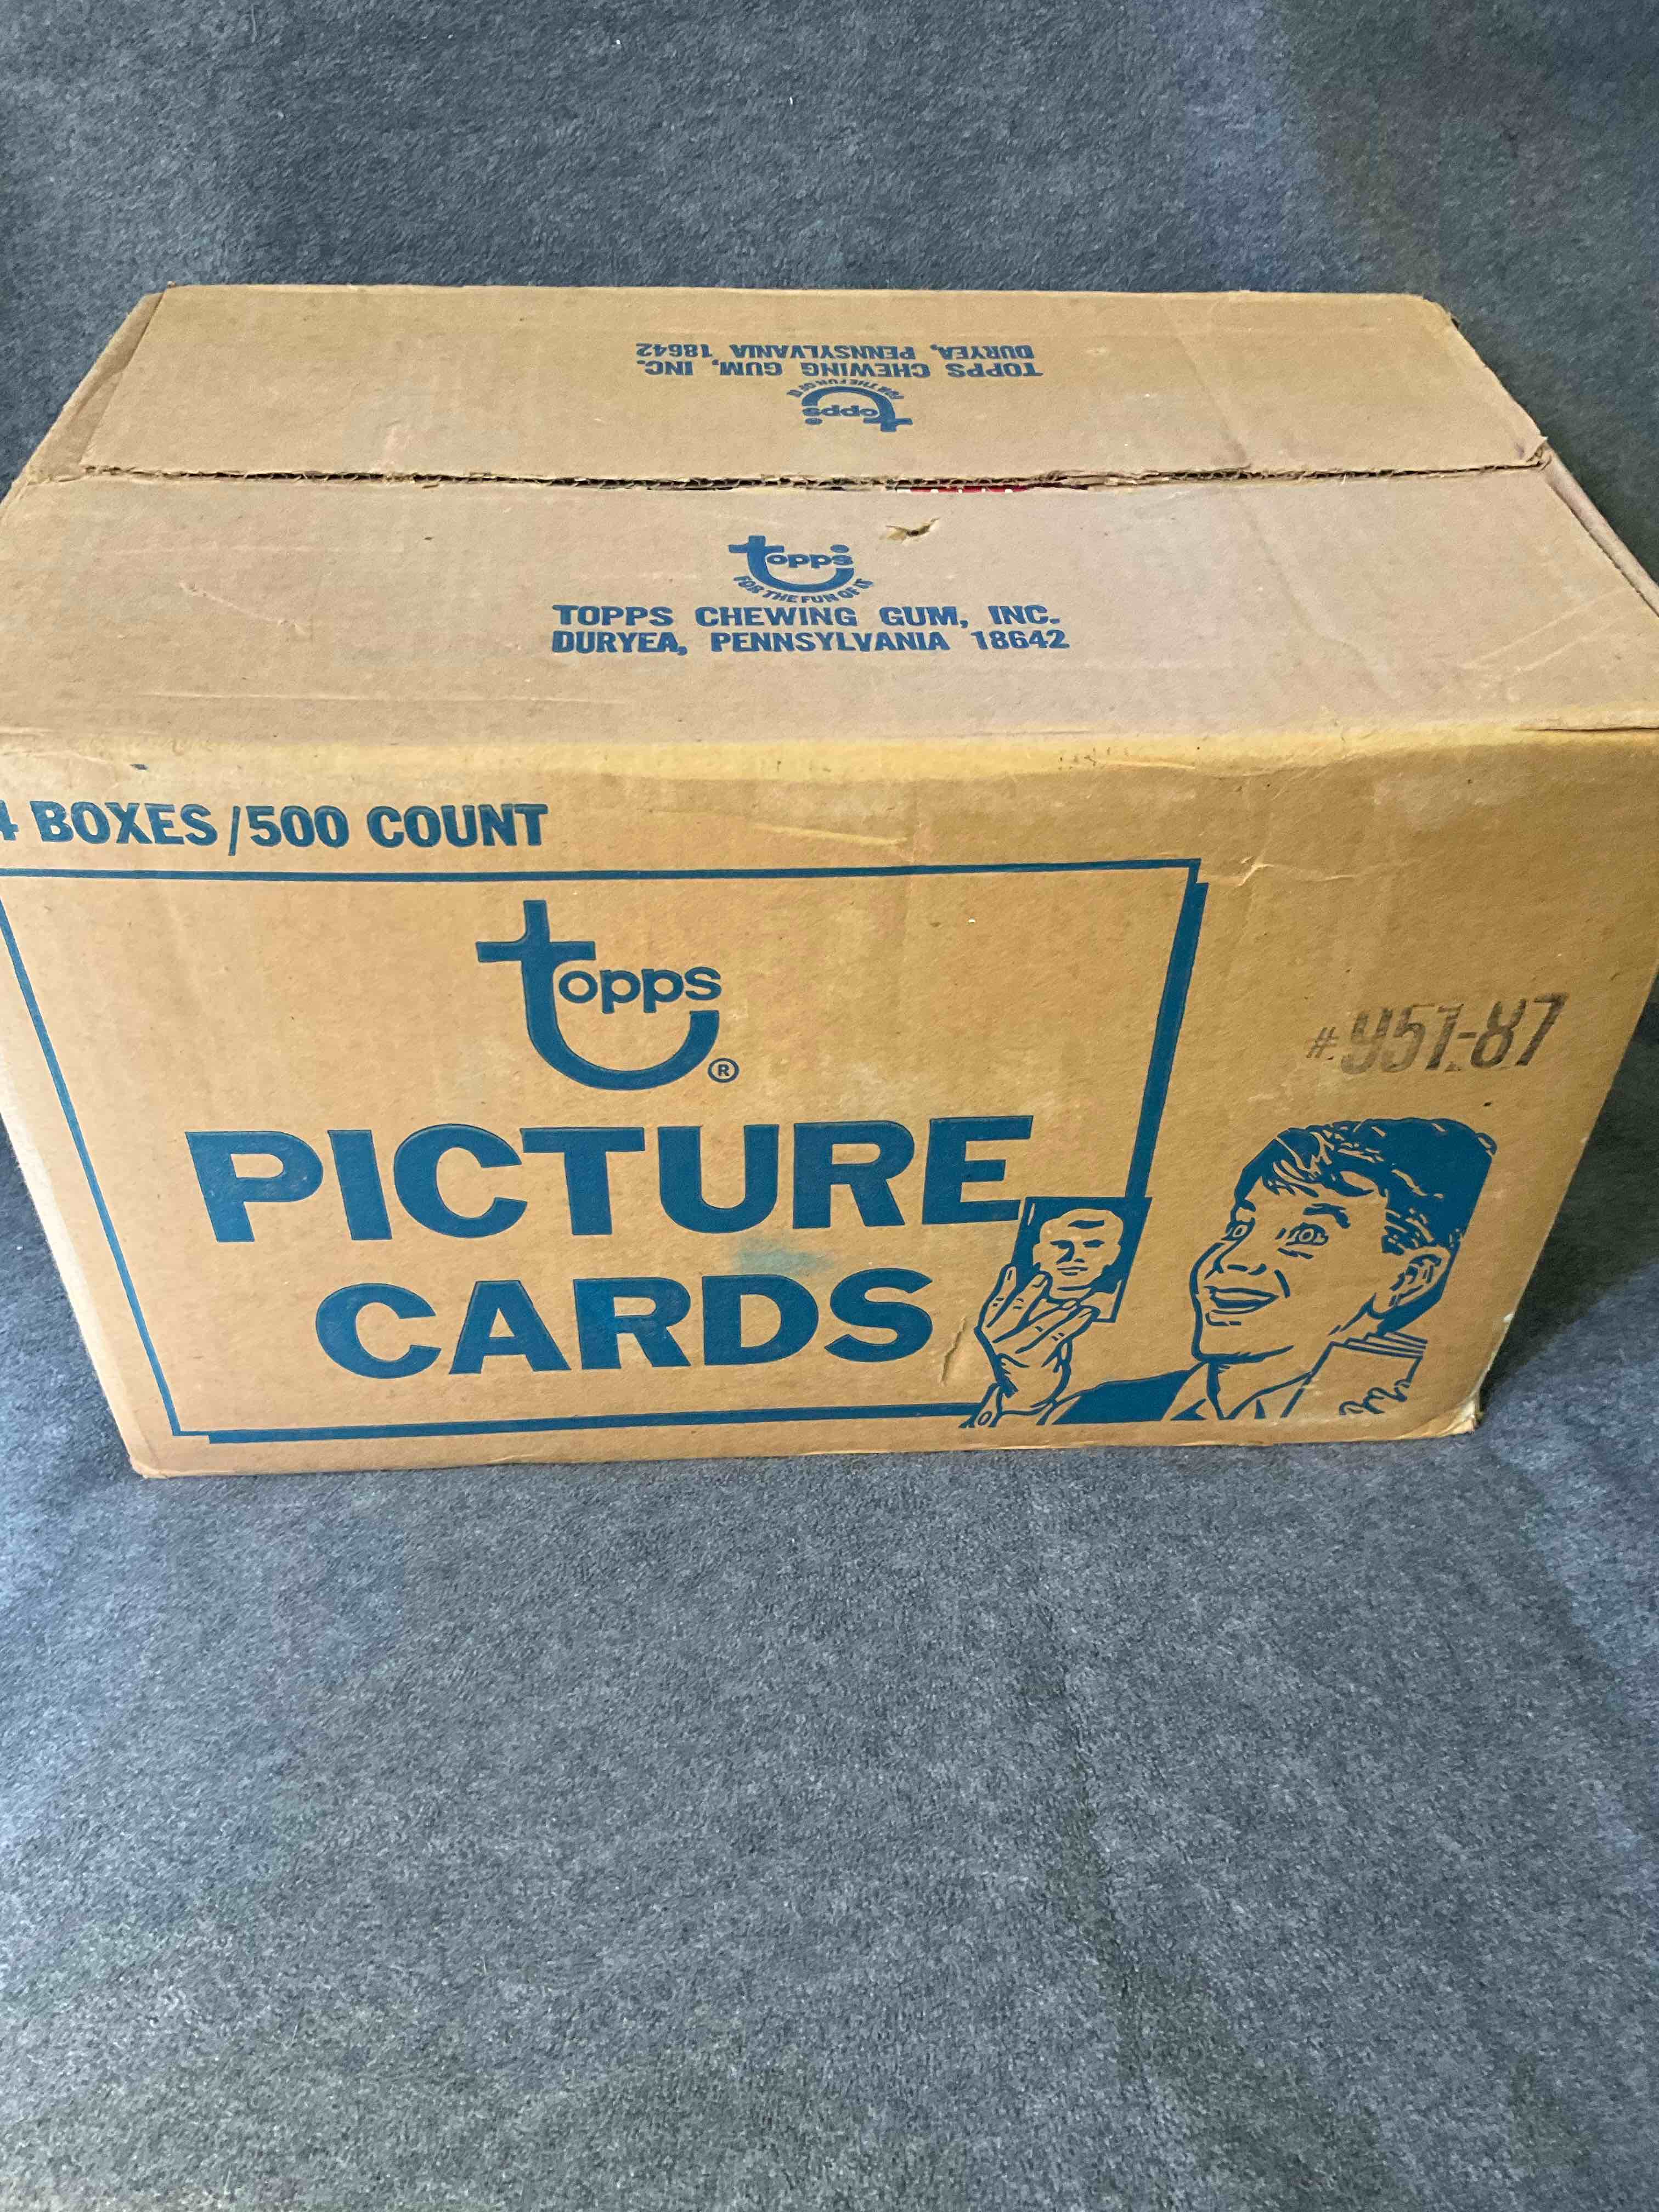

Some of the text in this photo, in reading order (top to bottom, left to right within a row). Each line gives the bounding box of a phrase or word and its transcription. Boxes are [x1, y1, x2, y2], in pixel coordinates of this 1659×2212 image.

[636, 343, 1035, 360] DURYEA, PENNSYLVANIA 18642
[636, 359, 1042, 378] TOPPS CHEWING GUM, INC.
[733, 576, 765, 593] FOR
[763, 590, 798, 602] THE
[801, 593, 839, 603] FUN
[837, 586, 860, 598] OF
[552, 604, 1061, 628] TOPPS CHEWING GUM, INC.
[552, 629, 1071, 656] DURYEA, PENNSYLVANIA 18642
[29, 800, 218, 846] BOXES
[367, 803, 549, 848] COUNT
[185, 1114, 1034, 1243] PICTURE
[314, 1267, 934, 1380] CARDS
